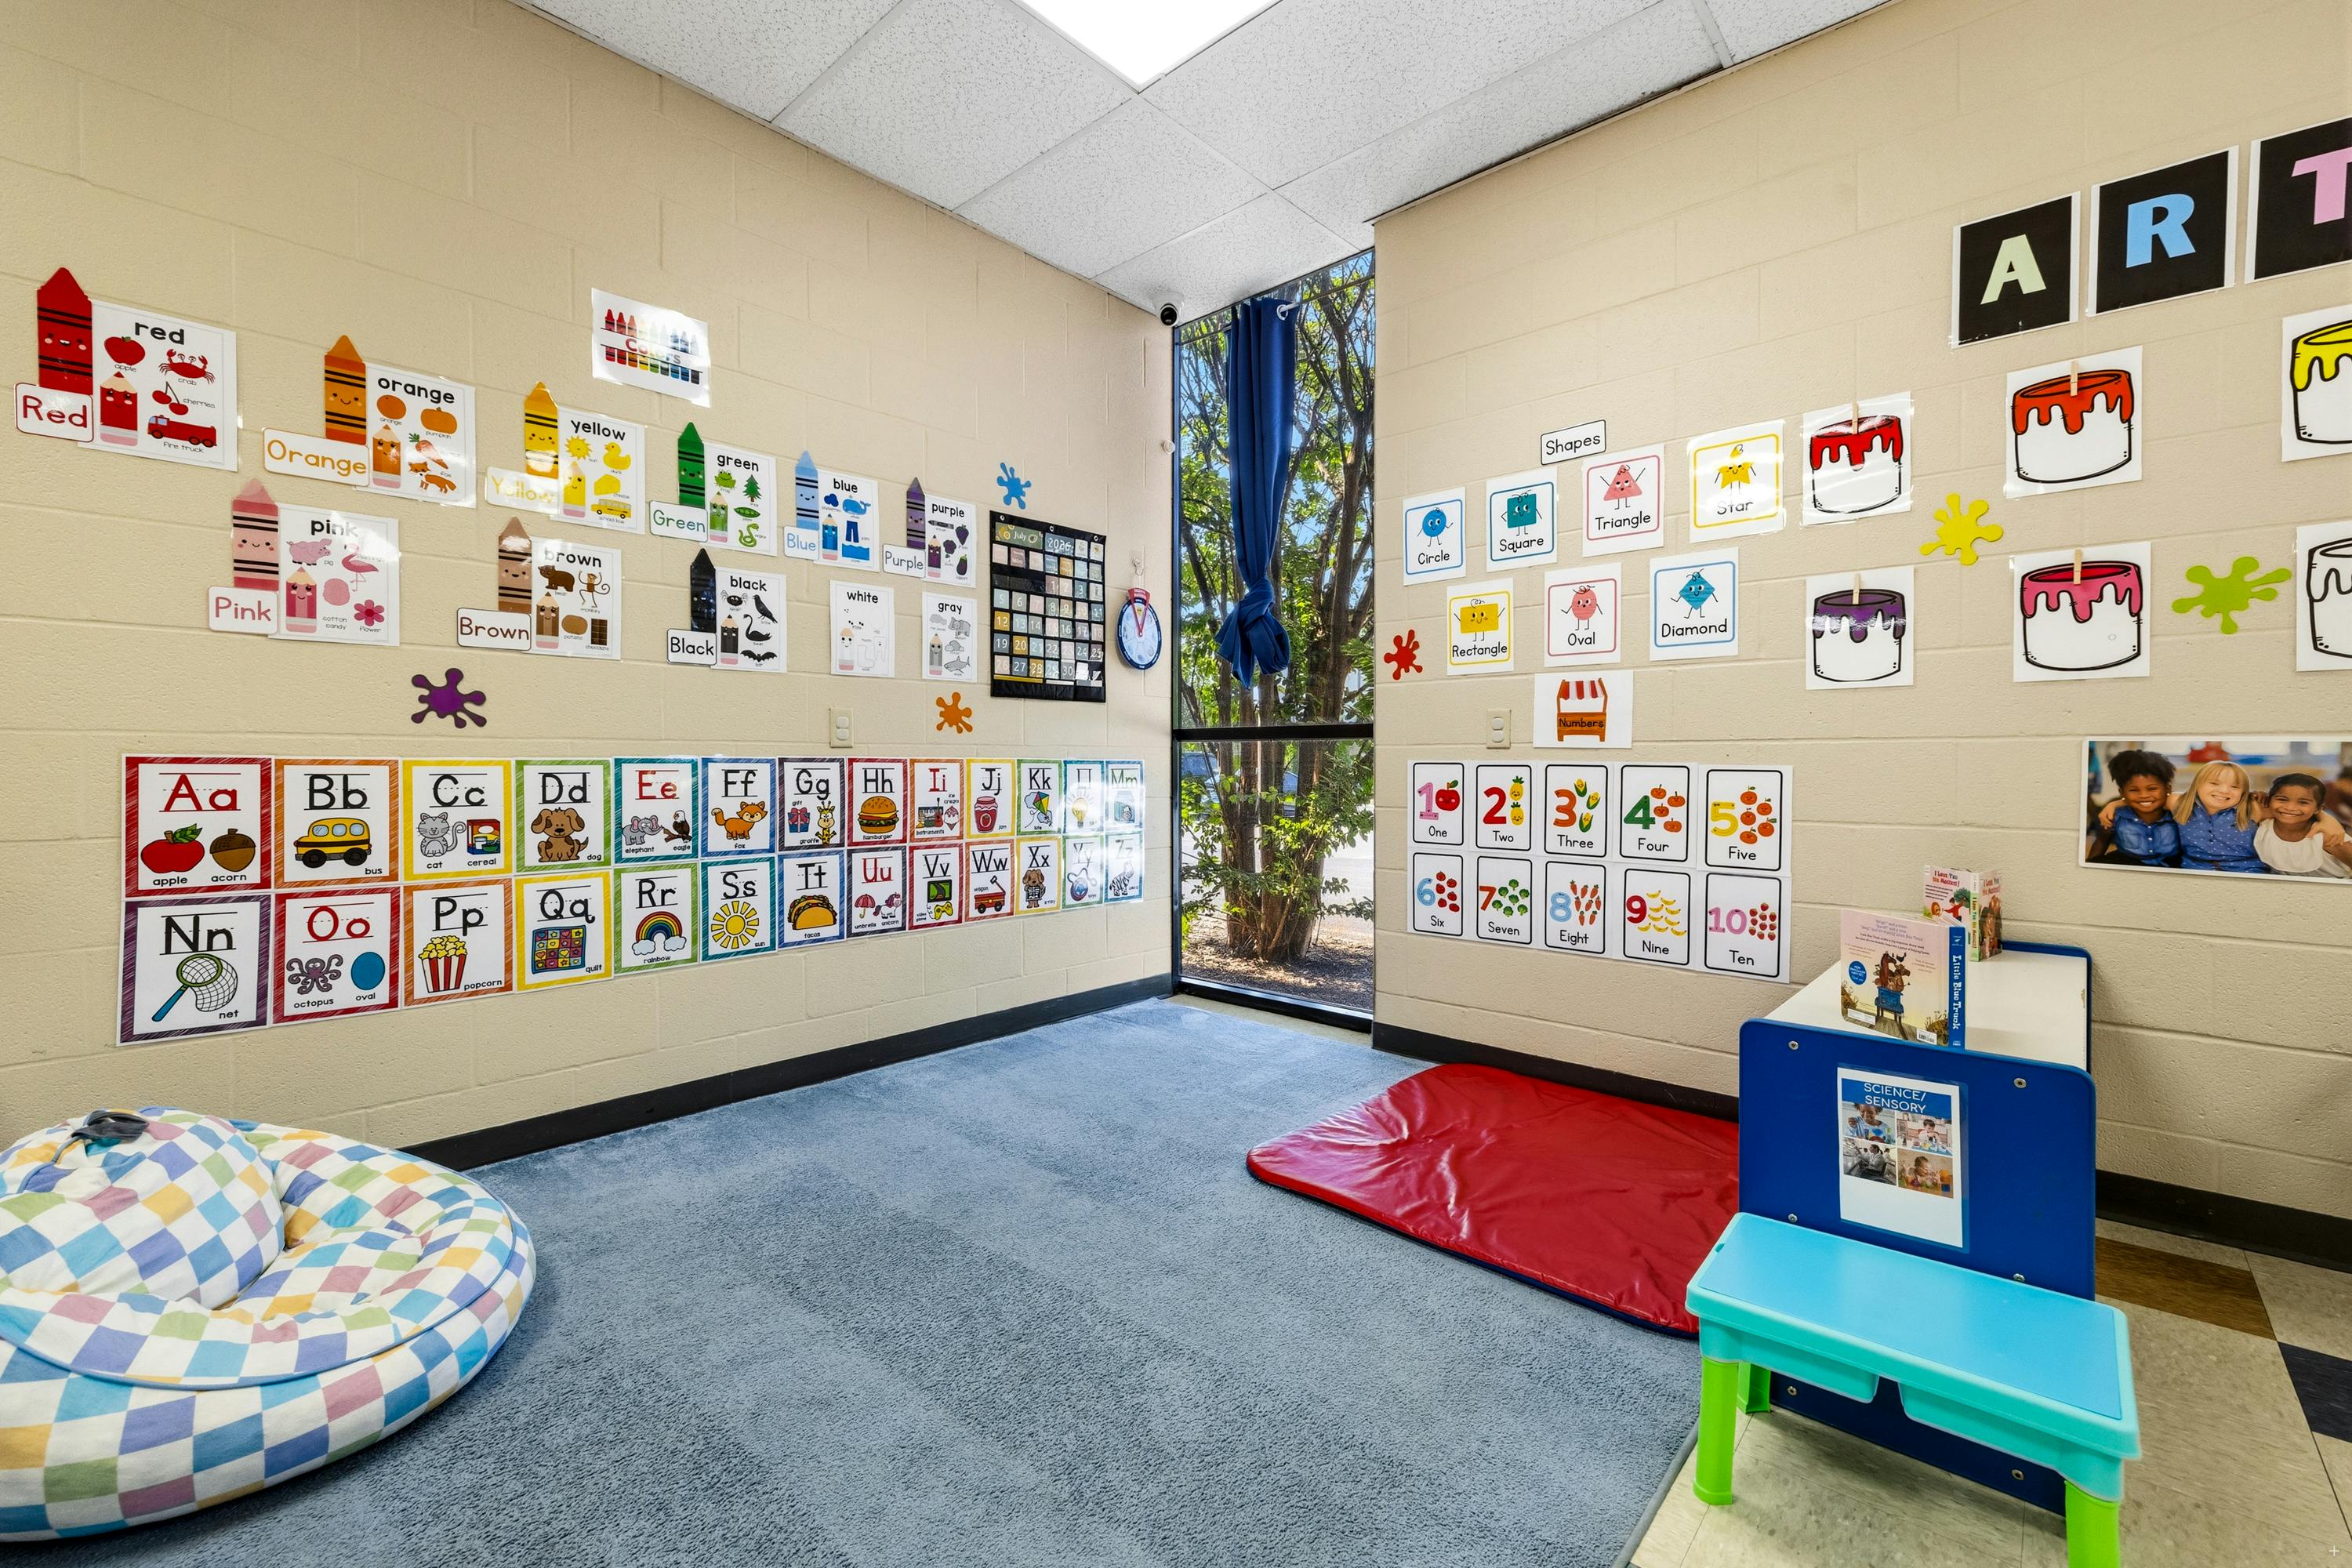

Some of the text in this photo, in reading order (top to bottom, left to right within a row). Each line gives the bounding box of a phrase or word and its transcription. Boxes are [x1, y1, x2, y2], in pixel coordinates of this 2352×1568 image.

[1980, 147, 2352, 304] ART
[135, 322, 184, 345] red
[114, 363, 137, 372] apple
[377, 377, 455, 404] orange
[23, 395, 88, 428] Red
[183, 397, 216, 408] cherries
[379, 416, 402, 426] orange
[571, 419, 626, 441] yellow
[426, 431, 451, 440] pumpkin
[163, 441, 205, 454] fire truck
[1545, 435, 1601, 456] Shapes
[267, 439, 366, 477] Orange
[717, 455, 759, 472] green
[491, 475, 553, 503] Yellow
[833, 478, 858, 493] blue
[931, 503, 965, 518] purple
[1716, 499, 1754, 515] Star
[310, 519, 358, 538] pink
[653, 510, 706, 532] Green
[1595, 511, 1651, 531] Triangle
[786, 533, 816, 551] Blue
[1013, 531, 1026, 540] July
[1499, 537, 1544, 553] Square
[544, 547, 601, 568] brown
[884, 551, 924, 572] Purple
[1417, 550, 1450, 564] Circle
[730, 575, 767, 592] black
[1079, 586, 1083, 596] 3
[847, 590, 878, 604] white
[1000, 594, 1004, 604] 5
[1017, 597, 1022, 607] 6
[215, 597, 271, 622] Pink
[938, 602, 962, 615] gray
[1051, 602, 1055, 612] 8
[1064, 604, 1069, 614] 9
[459, 616, 529, 641] Brown
[996, 616, 1008, 627] 12
[1015, 619, 1025, 628] 13
[1031, 620, 1040, 630] 14
[1062, 624, 1071, 634] 16
[1661, 618, 1728, 637] Diamond
[670, 637, 714, 655] Black
[996, 638, 1007, 648] 19
[1014, 640, 1026, 651] 20
[1032, 643, 1042, 652] 21
[1567, 631, 1595, 646] Oval
[1047, 644, 1058, 655] 22
[1077, 647, 1087, 656] 24
[1091, 648, 1101, 659] 25
[1452, 641, 1508, 659] Rectangle
[997, 660, 1007, 670] 26
[1014, 661, 1025, 672] 27
[1031, 662, 1043, 674] 28
[1063, 666, 1073, 675] 30
[1559, 717, 1604, 728] Numbers
[638, 770, 677, 799] Ee
[724, 770, 756, 797] Ff
[796, 768, 829, 800] Gg
[864, 768, 893, 793] Hh
[929, 768, 946, 792] Ii
[982, 768, 1000, 796] Jj
[1029, 768, 1051, 789] Kk
[1111, 768, 1137, 789] Mm
[164, 773, 237, 811] Aa
[309, 774, 368, 810] Bb
[433, 774, 485, 807] Cc
[542, 773, 587, 804] Dd
[1417, 782, 1439, 821] 1
[1483, 786, 1507, 825] 2
[1553, 789, 1577, 828] 3
[1623, 794, 1656, 829] 4
[1710, 801, 1740, 837] 5
[1428, 826, 1447, 837] One
[1493, 830, 1514, 843] Two
[1557, 833, 1594, 849] Three
[1638, 837, 1669, 853] Four
[586, 853, 602, 862] dog
[972, 850, 1007, 873] Ww
[1028, 846, 1050, 868] Xx
[1073, 843, 1094, 868] Yy
[1728, 846, 1757, 861] Five
[365, 866, 383, 875] bus
[863, 858, 891, 882] Uu
[924, 855, 949, 877] Vv
[152, 876, 188, 887] apple
[211, 873, 247, 883] acorn
[722, 872, 756, 898] Ss
[798, 863, 827, 889] Tt
[638, 879, 677, 908] Rr
[1416, 877, 1436, 906] 6
[1479, 885, 1497, 911] 7
[540, 889, 595, 924] Qq
[1549, 891, 1573, 923] 8
[1625, 895, 1647, 924] 9
[307, 906, 370, 942] Oo
[435, 897, 484, 936] Pp
[1430, 915, 1445, 927] Six
[1708, 906, 1748, 935] 10
[165, 915, 234, 954] Nn
[1488, 921, 1520, 936] Seven
[1559, 929, 1589, 946] Eight
[1642, 940, 1670, 955] Nine
[644, 955, 671, 964] rainbow
[1729, 949, 1755, 966] Ten
[585, 964, 602, 974] quilt
[1952, 955, 1962, 979] Little
[463, 979, 502, 991] popcorn
[1953, 982, 1962, 1001] Blue
[293, 997, 334, 1009] octopus
[355, 993, 376, 1001] oval
[218, 1009, 239, 1019] net
[1952, 1001, 1962, 1029] Truck
[1864, 1083, 1926, 1102] SCIENCE/
[1864, 1094, 1926, 1114] SENSORY
